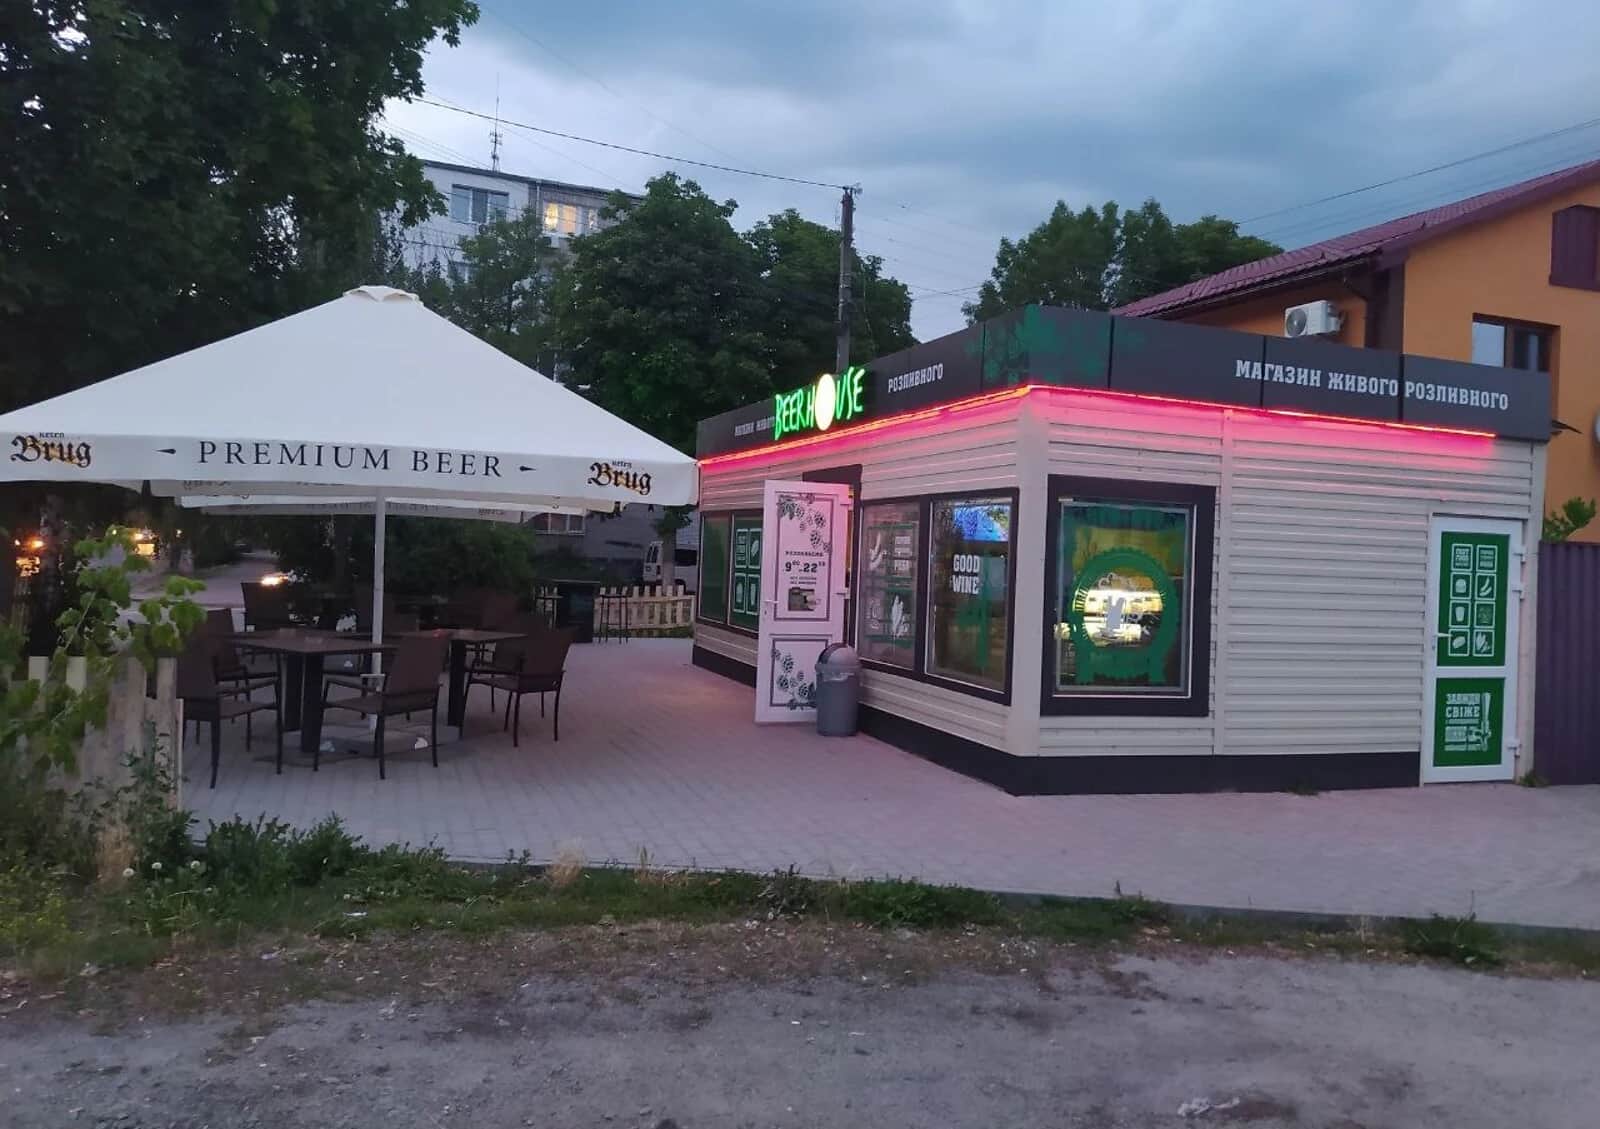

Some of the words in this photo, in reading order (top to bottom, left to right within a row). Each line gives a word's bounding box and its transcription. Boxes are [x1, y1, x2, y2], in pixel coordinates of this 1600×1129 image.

[888, 363, 944, 393] РОЗЛИВНОГО
[1235, 359, 1321, 387] МАГАЗИН
[1328, 371, 1399, 398] ЖИВОГО
[1405, 380, 1509, 410] РОЗЛИВНОГО
[10, 435, 91, 468] Brug
[199, 440, 391, 470] PREMIUM
[412, 450, 503, 477] BEER
[587, 462, 652, 496] Brug
[953, 554, 981, 573] GOOD
[951, 575, 980, 595] WINE
[1445, 706, 1480, 718] СВІЖЕ
